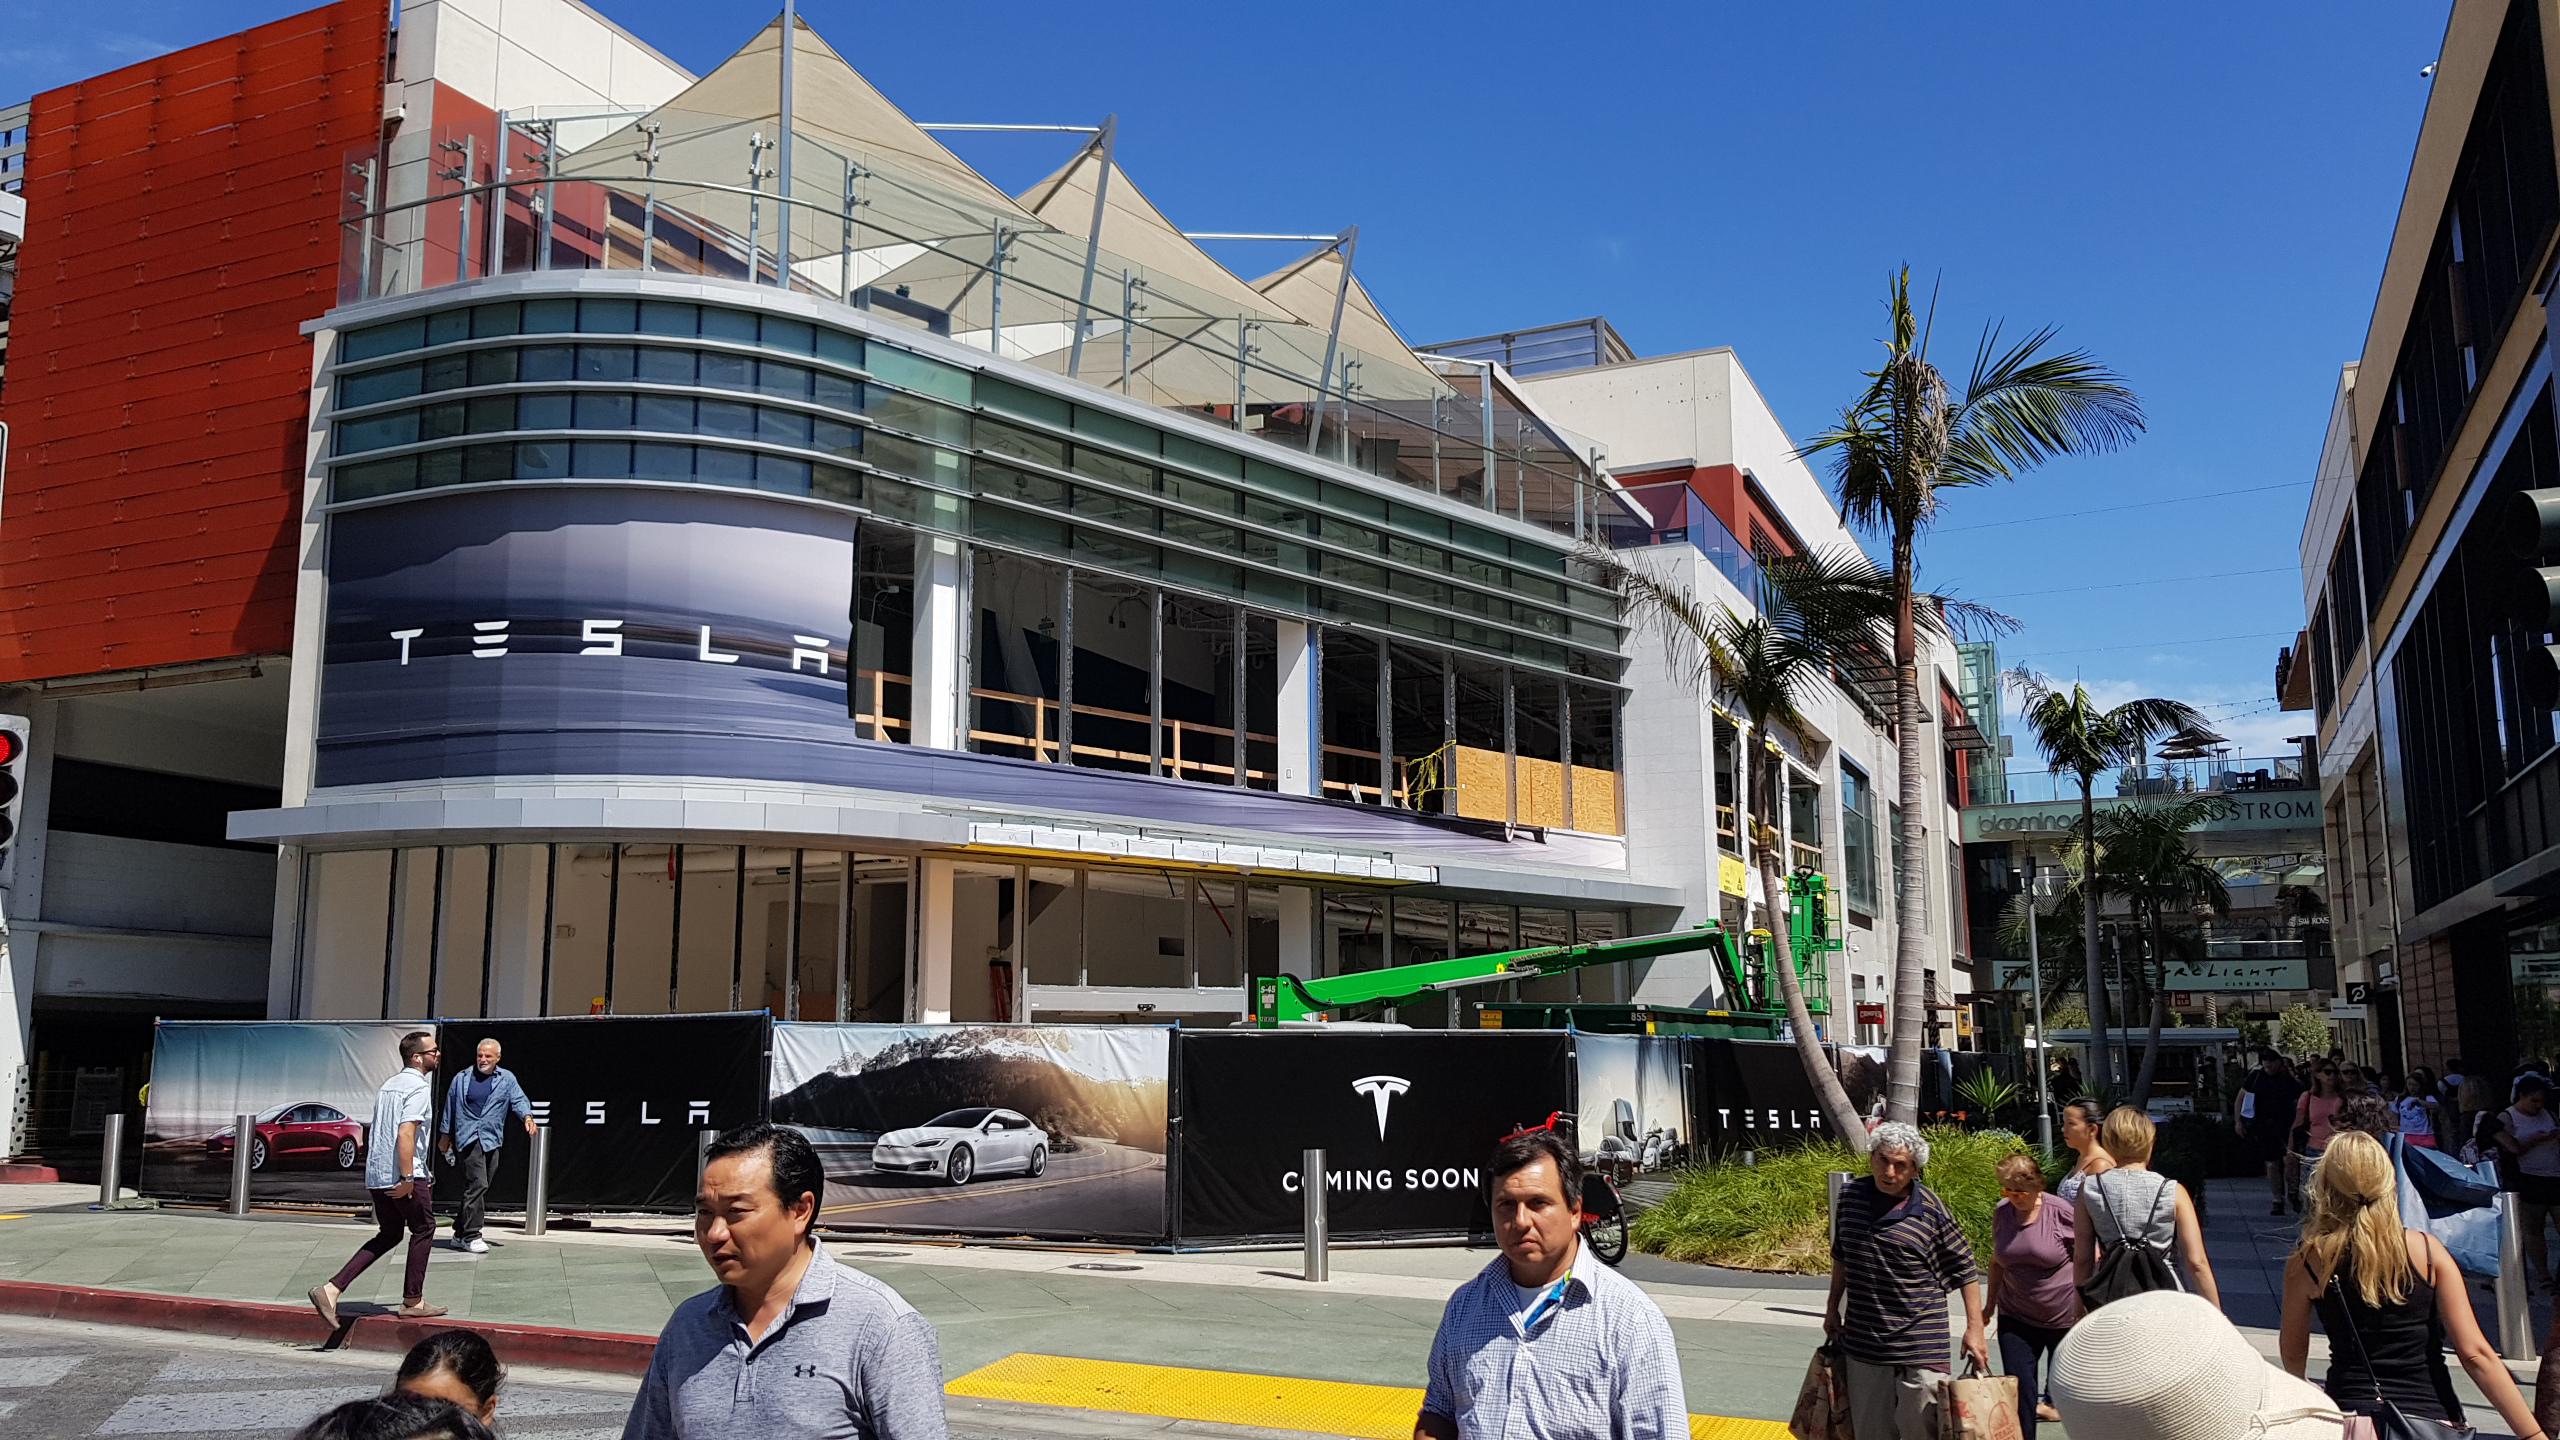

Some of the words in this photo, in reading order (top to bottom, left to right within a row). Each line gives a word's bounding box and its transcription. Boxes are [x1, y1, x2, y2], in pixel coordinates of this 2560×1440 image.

[389, 619, 830, 674] TESLA
[1260, 984, 1277, 993] S-45
[1630, 1013, 1647, 1022] 855
[530, 1101, 711, 1125] ESLA
[1718, 1108, 1821, 1129] TESLA
[1282, 1169, 1393, 1191] CMING
[1405, 1168, 1479, 1189] SOON
